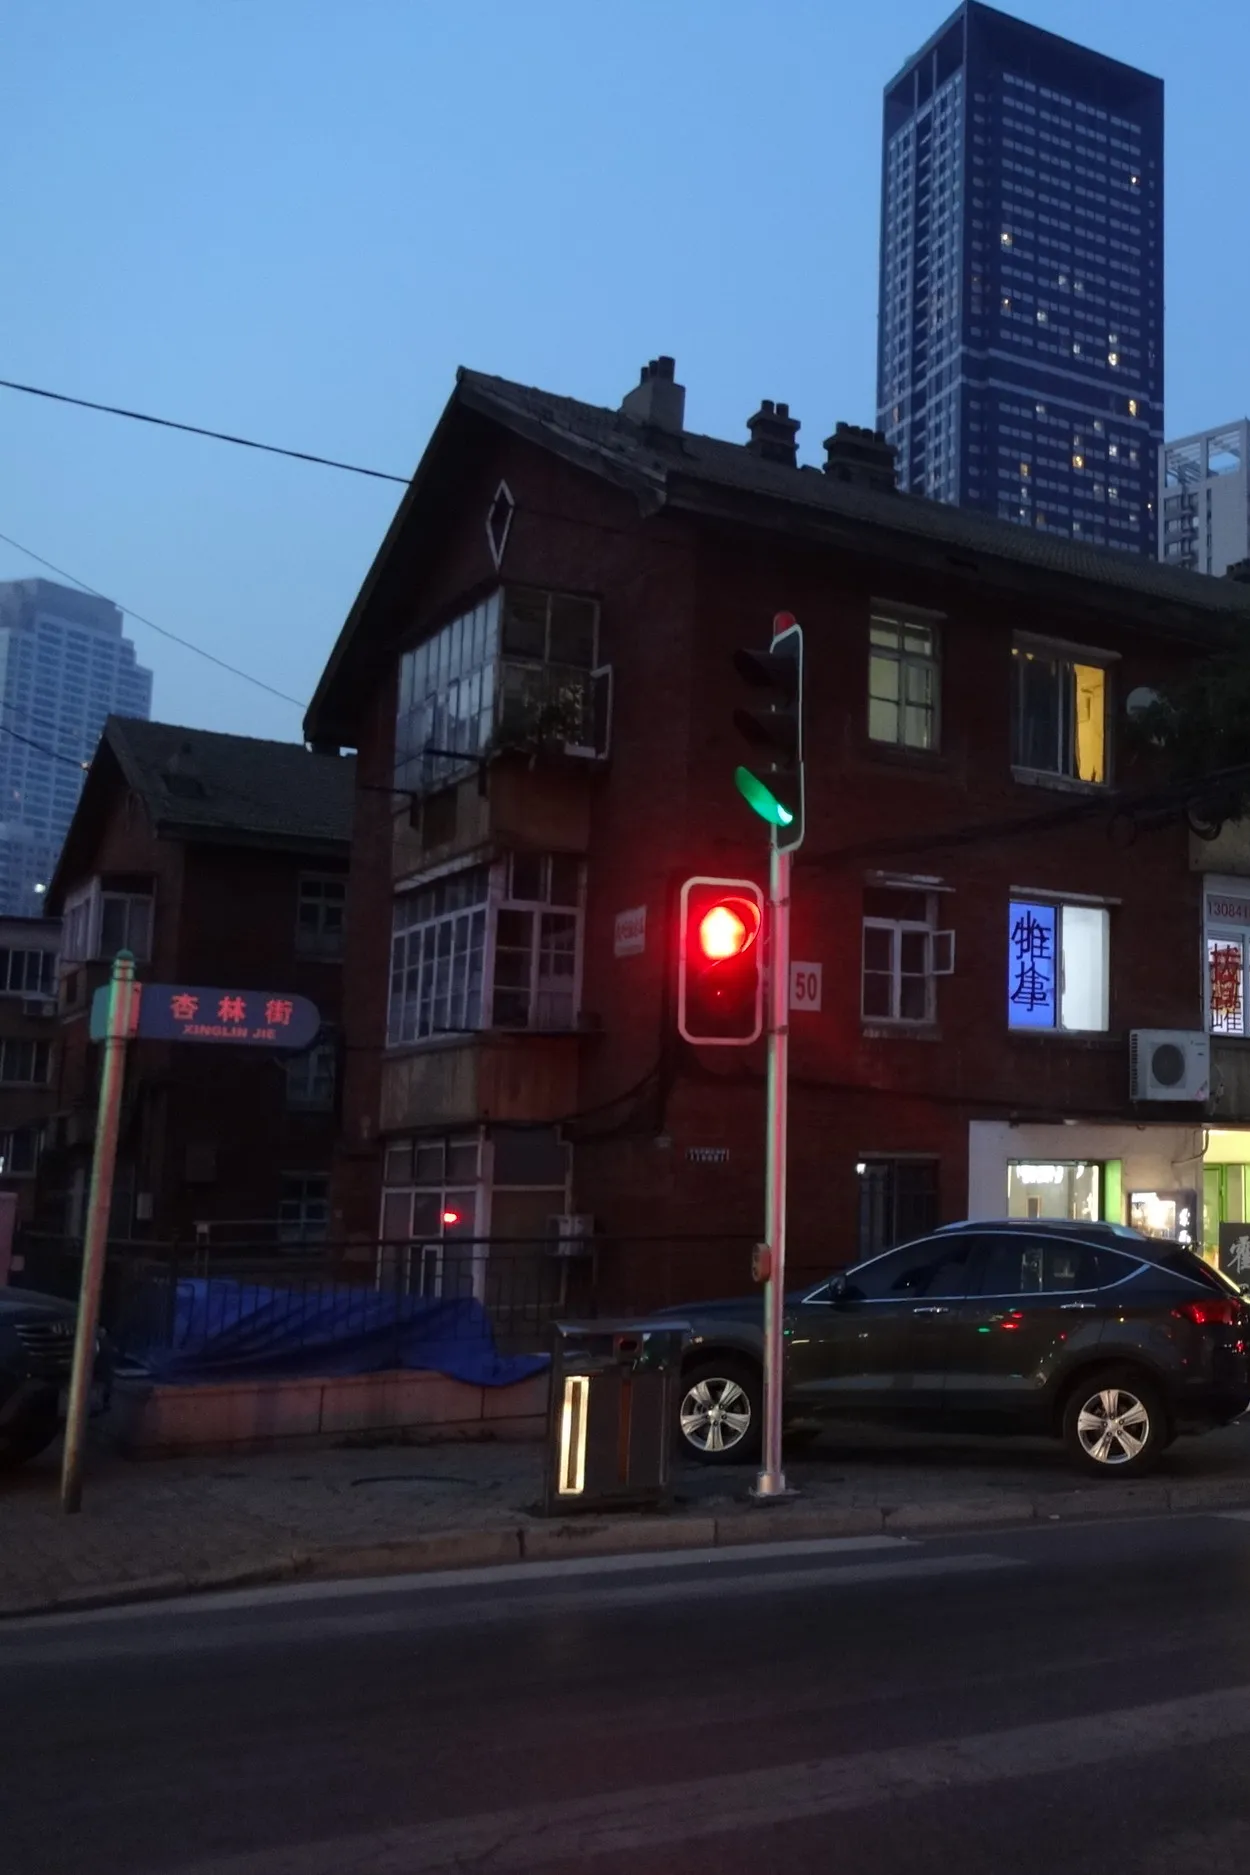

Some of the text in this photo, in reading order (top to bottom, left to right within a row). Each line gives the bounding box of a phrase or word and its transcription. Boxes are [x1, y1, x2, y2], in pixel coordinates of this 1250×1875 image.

[795, 971, 818, 1002] 50
[170, 993, 293, 1026] 杏林街
[183, 1024, 276, 1040] XINGLIN JIE
